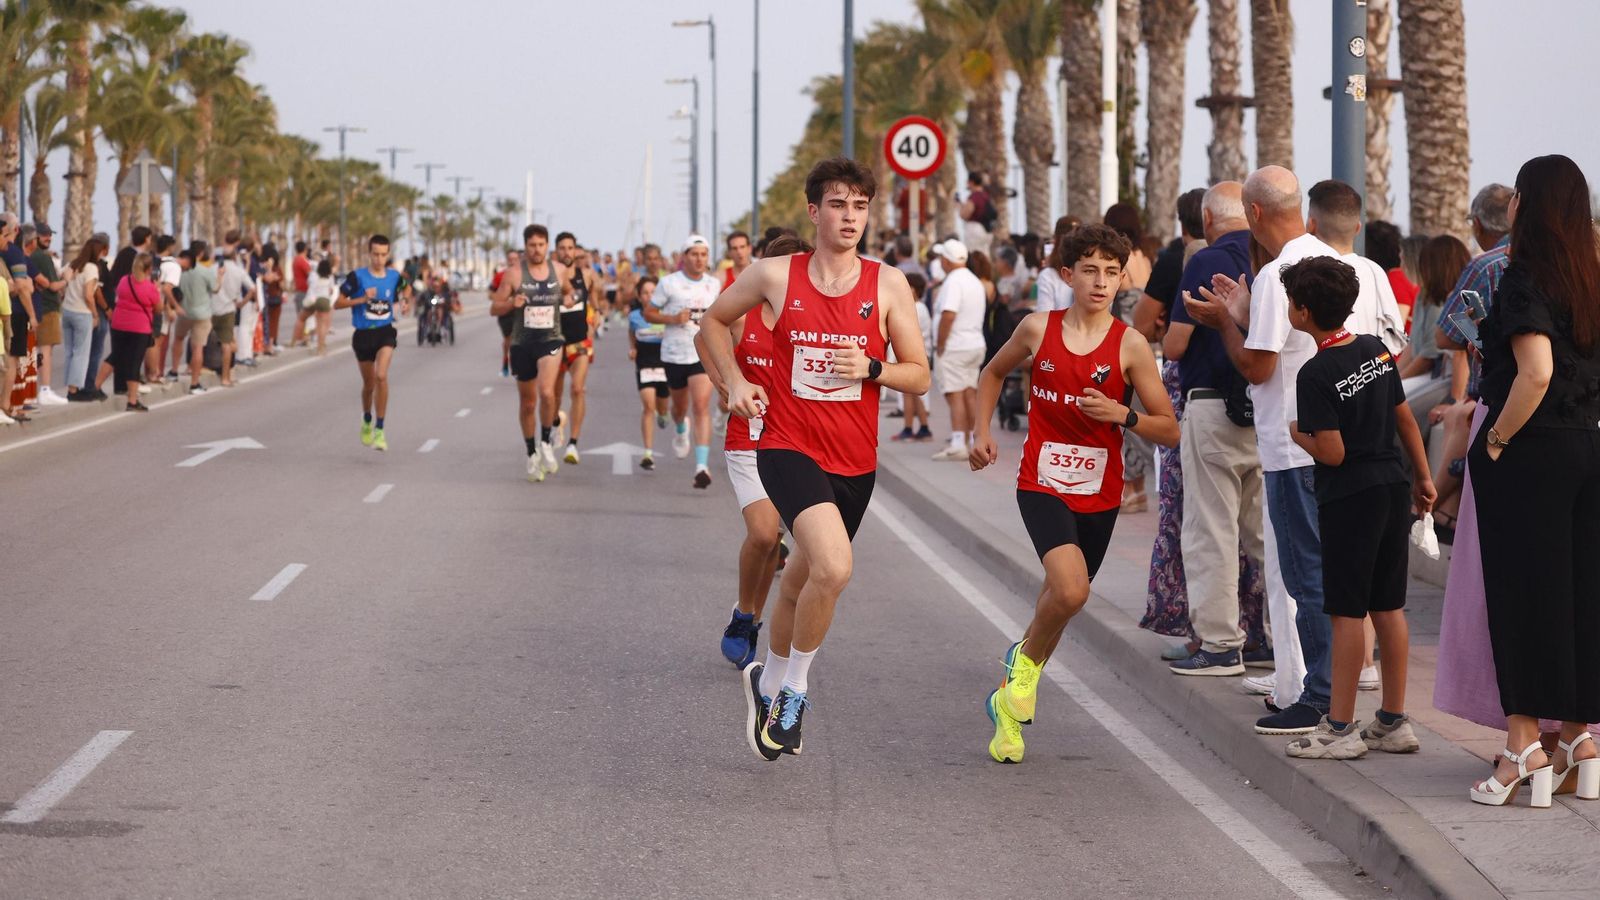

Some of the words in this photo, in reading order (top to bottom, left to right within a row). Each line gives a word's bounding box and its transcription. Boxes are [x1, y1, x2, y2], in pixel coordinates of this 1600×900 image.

[898, 136, 929, 158] 40
[790, 330, 818, 343] SAN
[821, 333, 867, 345] PEDRO
[746, 356, 766, 367] SAN
[1032, 385, 1057, 402] SAN
[1049, 452, 1096, 471] 3376
